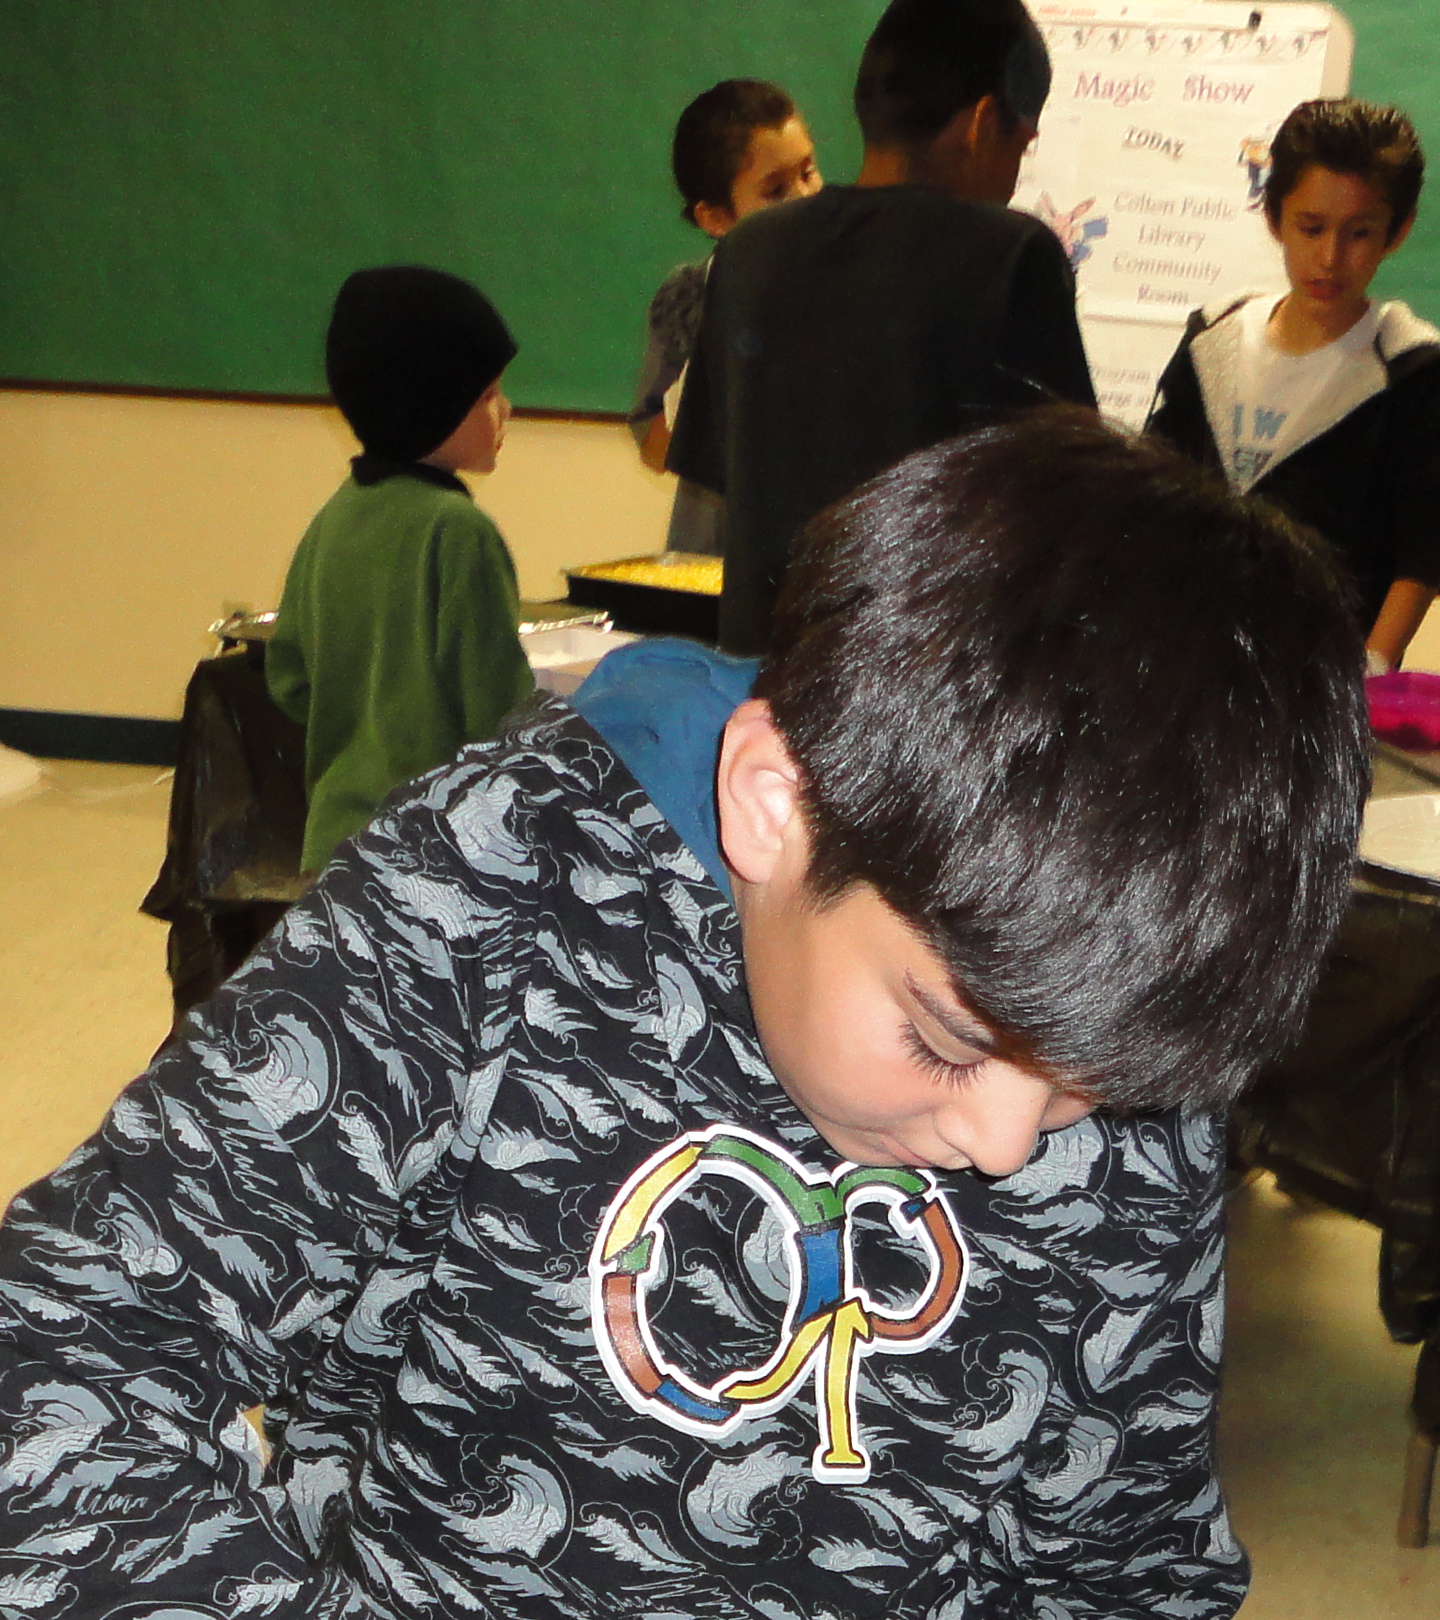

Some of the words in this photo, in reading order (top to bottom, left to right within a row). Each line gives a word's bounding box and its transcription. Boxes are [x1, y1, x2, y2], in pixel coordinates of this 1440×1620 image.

[1073, 71, 1156, 107] Magic
[1182, 73, 1255, 104] Show
[1122, 124, 1185, 160] TODAY
[1181, 197, 1235, 220] Public
[1138, 224, 1206, 254] Library
[1112, 253, 1222, 285] Community
[1137, 284, 1189, 305] Room
